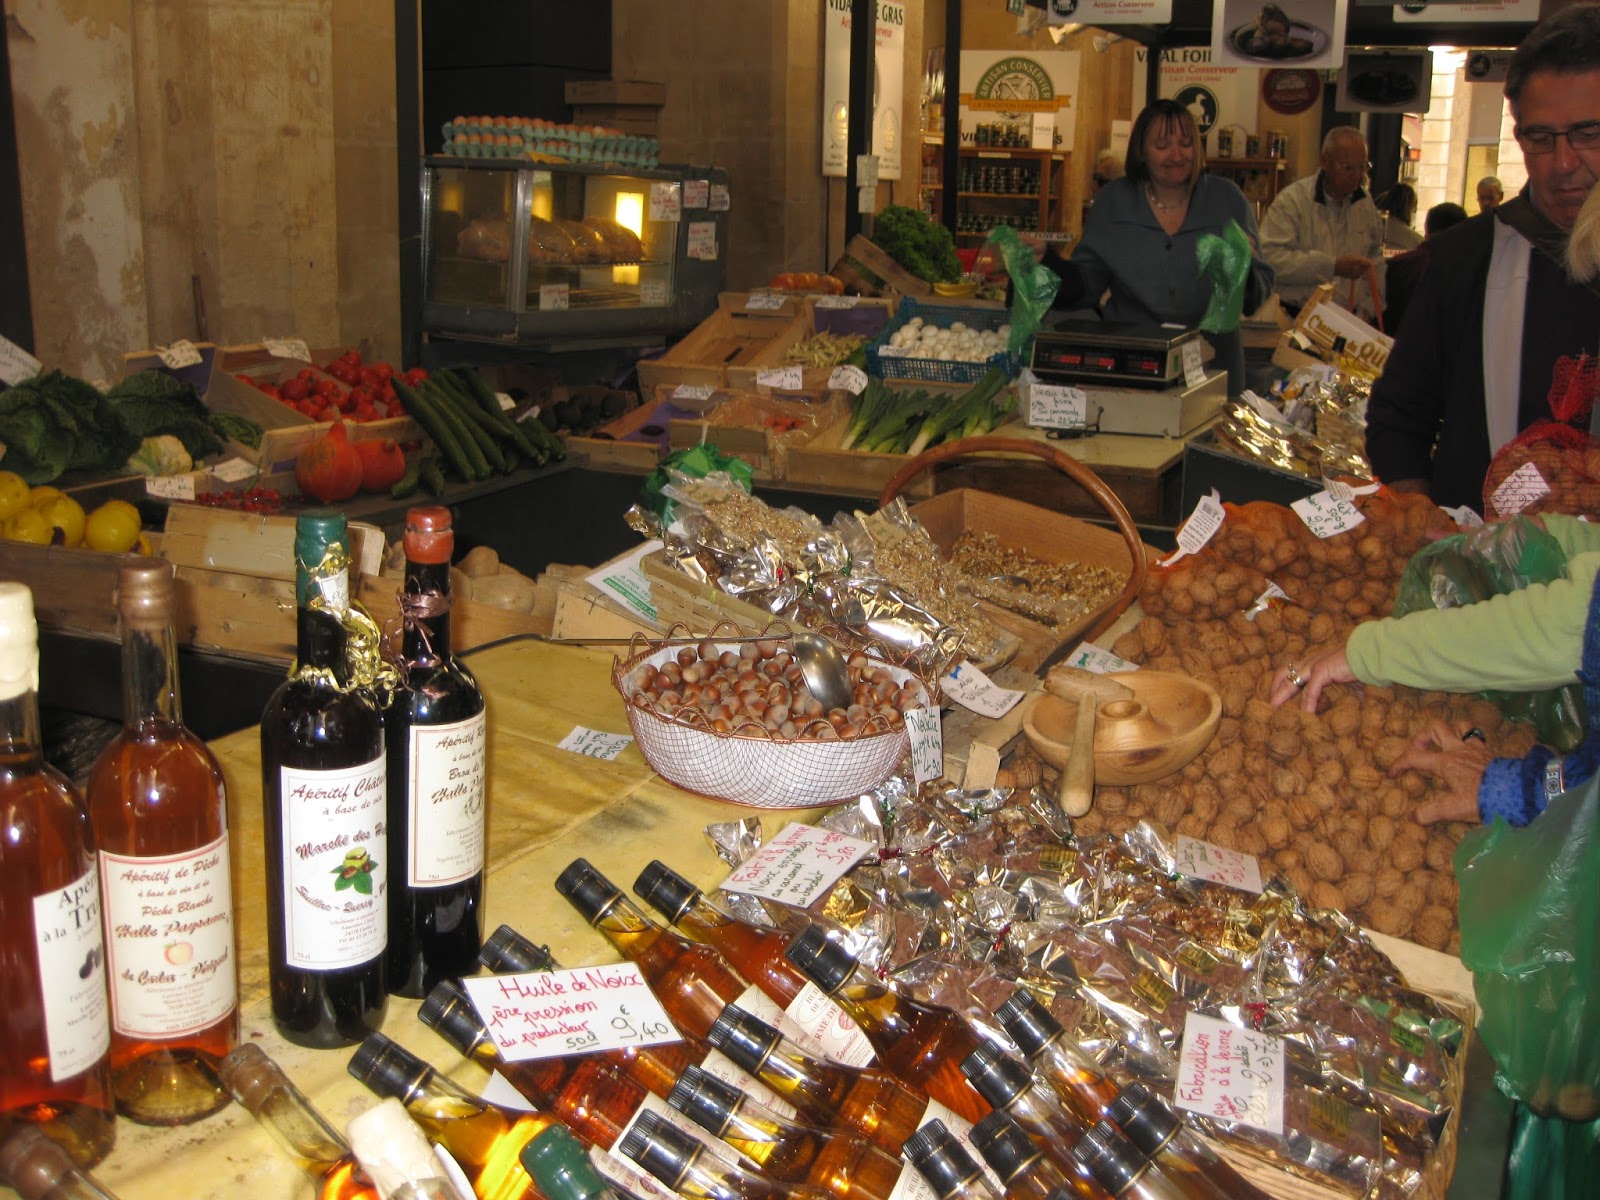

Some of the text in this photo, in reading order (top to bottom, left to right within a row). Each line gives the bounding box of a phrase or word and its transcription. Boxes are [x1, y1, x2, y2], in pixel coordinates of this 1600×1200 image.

[882, 5, 903, 25] GRAS
[1136, 50, 1177, 62] VAL
[980, 61, 1051, 98] ARTISAN CONSERVIER
[1188, 65, 1238, 73] Conserveur
[435, 732, 475, 750] Apéritif
[449, 767, 470, 781] Brou
[291, 783, 350, 802] Apéritif
[323, 807, 329, 815] à
[335, 805, 357, 815] base
[361, 800, 370, 809] de
[295, 830, 371, 860] Marché des
[120, 854, 220, 884] Apéritif de Pêche
[731, 862, 766, 882] Fait
[772, 862, 806, 897] au caramel
[146, 889, 164, 897] base
[167, 888, 177, 896] de
[790, 884, 801, 892] ou
[798, 870, 824, 896] chocolat
[142, 894, 213, 917] Pêche Blanche
[343, 899, 374, 913] Quercy
[43, 929, 52, 943] à
[52, 927, 67, 941] la
[498, 969, 644, 1000] Huile de Noix
[523, 1000, 598, 1026] pression
[500, 1021, 590, 1048] du producteur
[611, 1016, 668, 1041] 9,40
[1180, 1033, 1211, 1101] Fabrication
[1210, 1029, 1242, 1087] à la ferme
